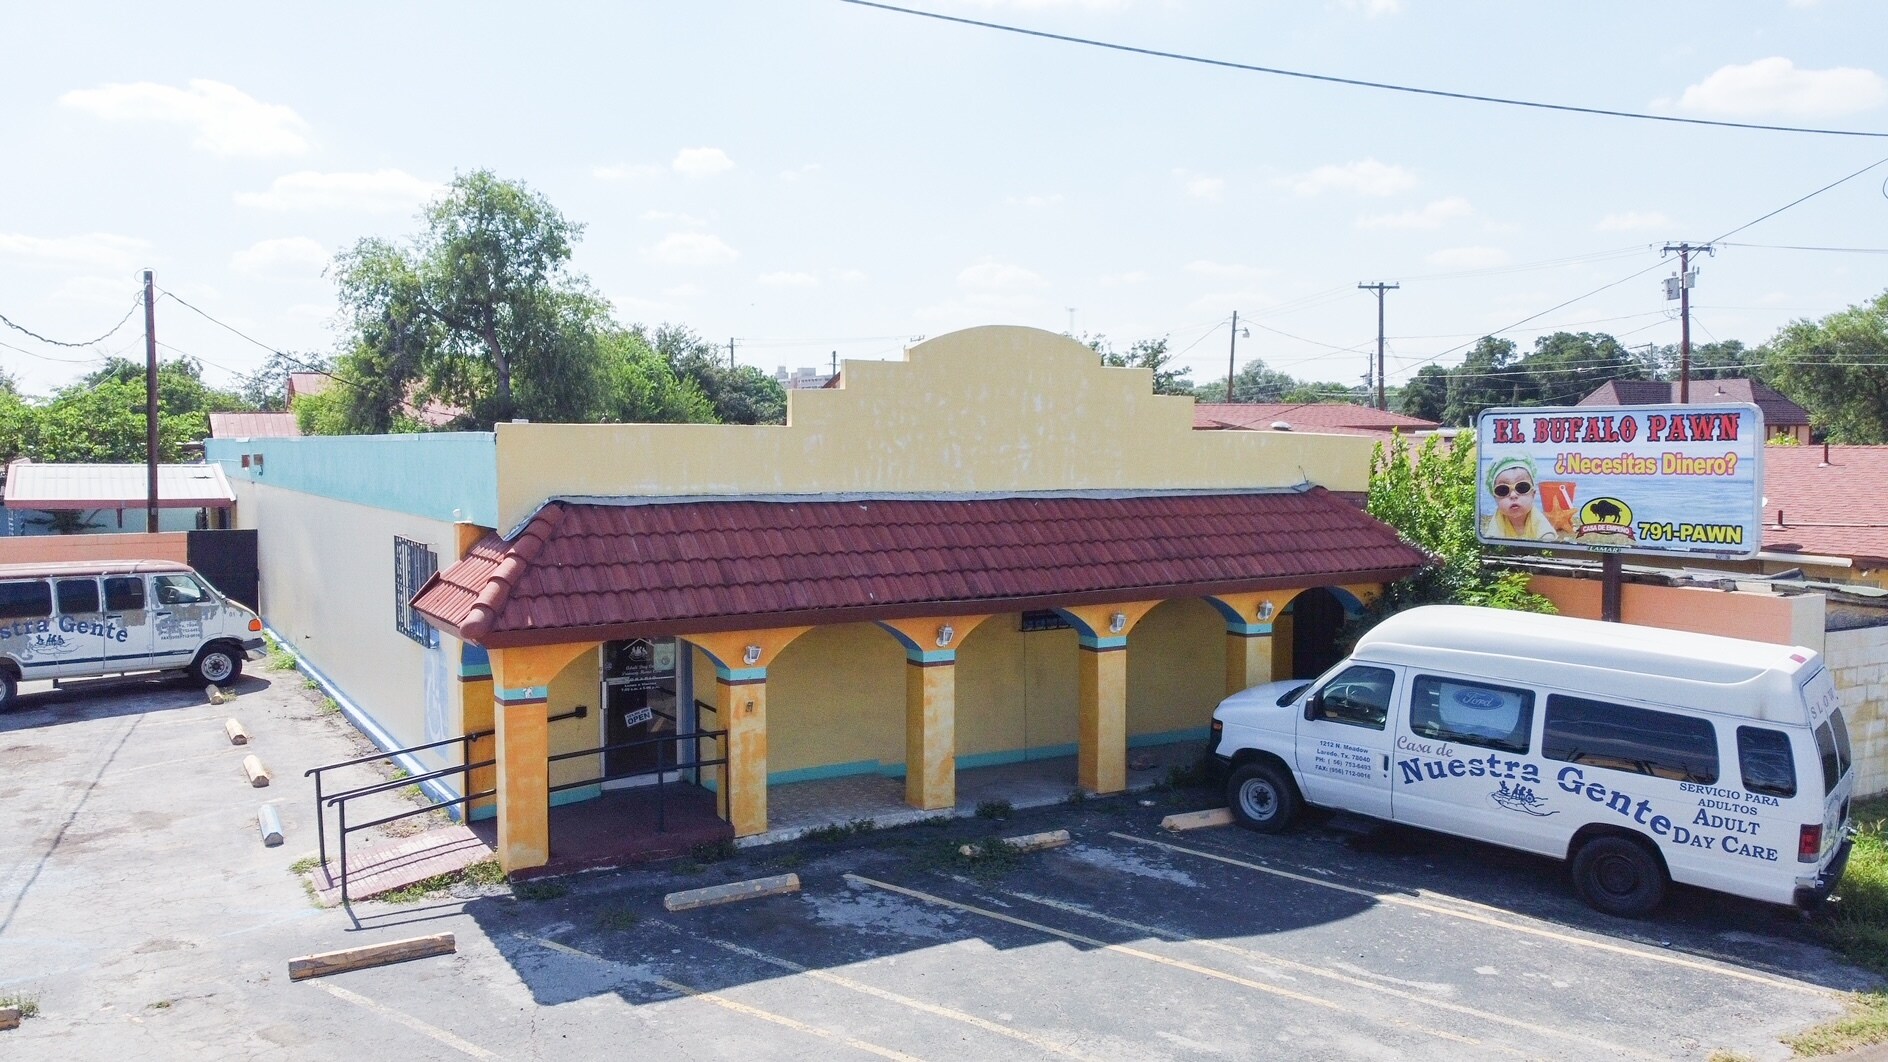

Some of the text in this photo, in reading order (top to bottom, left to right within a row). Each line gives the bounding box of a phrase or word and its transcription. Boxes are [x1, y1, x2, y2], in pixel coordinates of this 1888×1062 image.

[1493, 413, 1740, 443] EL BUFALO PAWN
[1554, 452, 1738, 475] ¿Necesitas Dinero?
[1638, 522, 1743, 544] 791-PAWN
[60, 615, 128, 642] Gente
[1462, 689, 1493, 707] Ford
[628, 712, 650, 724] OPEN
[1343, 744, 1368, 753] Meadow
[1397, 735, 1454, 758] Casa de
[1398, 754, 1673, 836] Nuestra Gente
[1680, 783, 1779, 807] SERVICIO PARA
[1697, 798, 1758, 816] ADULTOS
[1693, 808, 1760, 835] ADULT
[1672, 826, 1778, 861] DAY CARE
